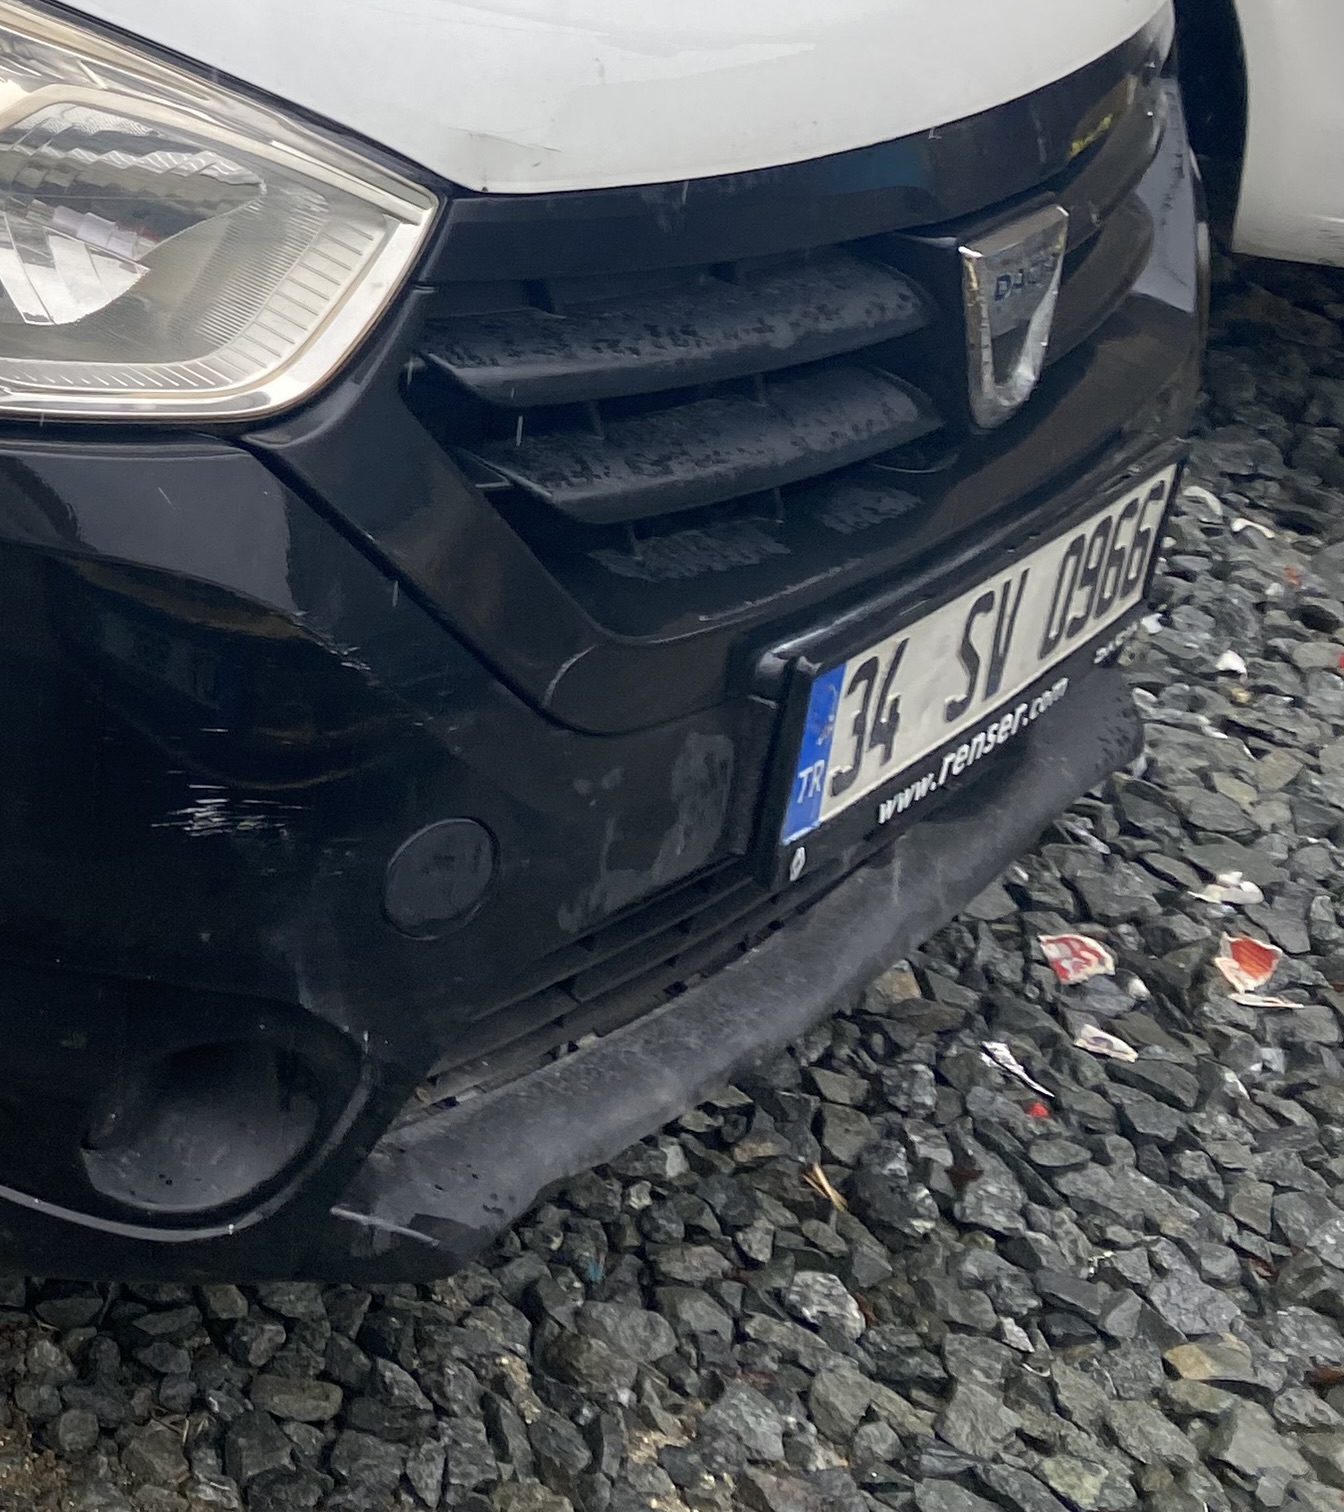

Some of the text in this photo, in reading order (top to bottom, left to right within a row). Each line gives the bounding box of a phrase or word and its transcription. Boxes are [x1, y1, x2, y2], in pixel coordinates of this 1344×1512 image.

[831, 479, 1166, 797] 34 SV 0966
[797, 759, 825, 805] TR
[877, 677, 1069, 824] www.renser.com
